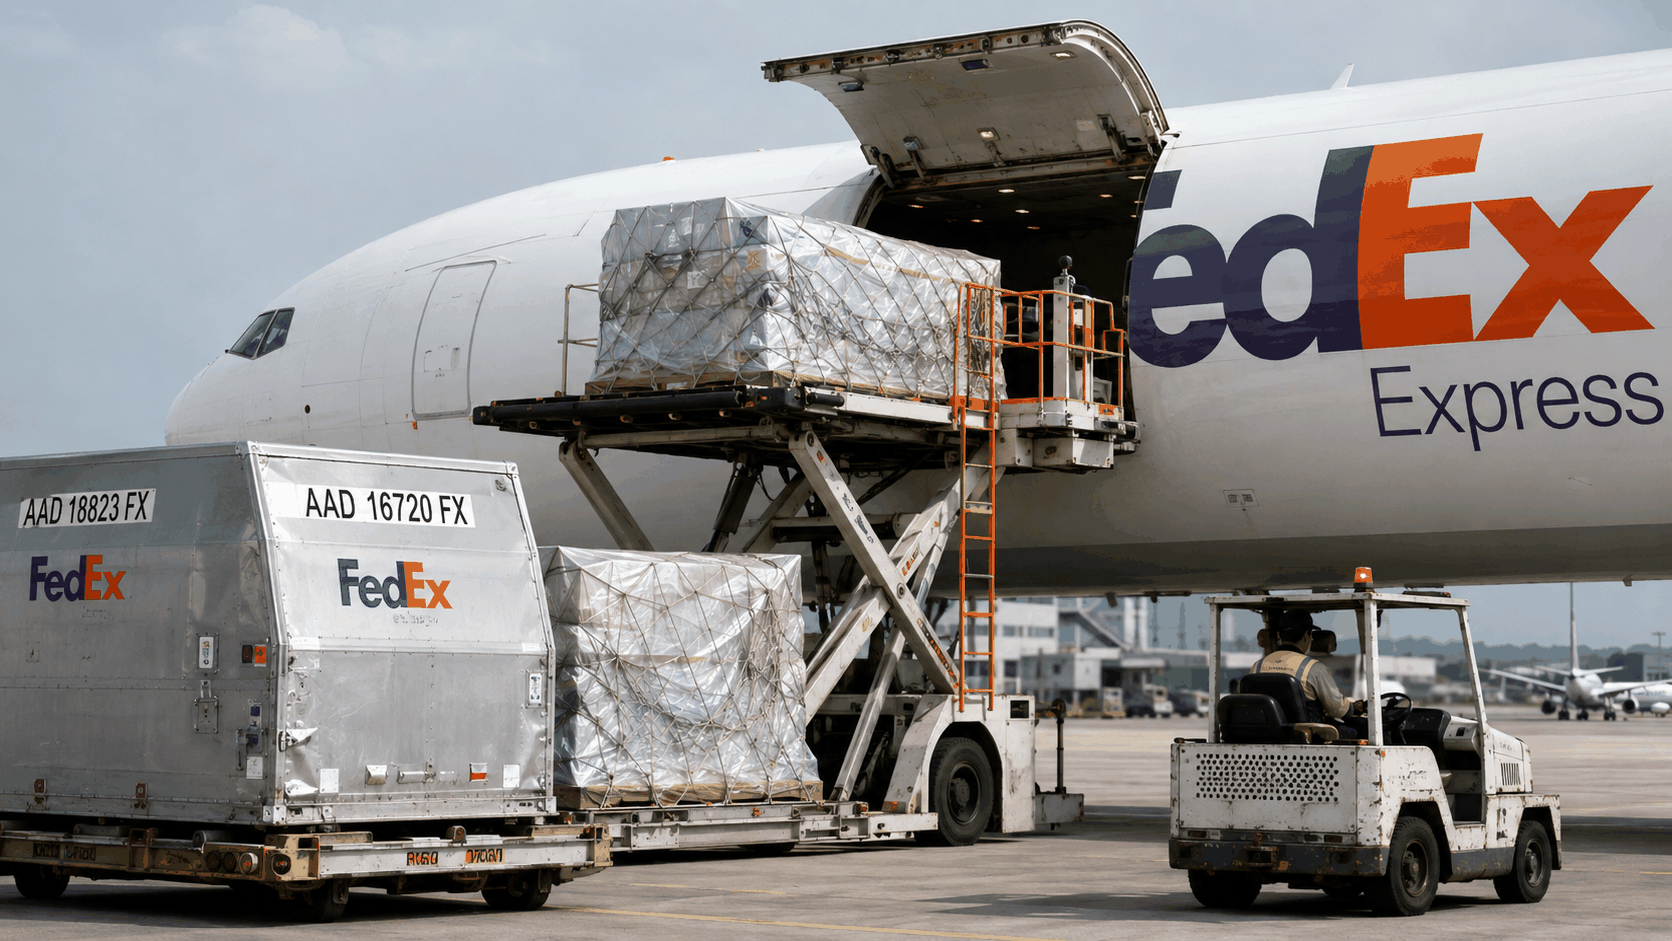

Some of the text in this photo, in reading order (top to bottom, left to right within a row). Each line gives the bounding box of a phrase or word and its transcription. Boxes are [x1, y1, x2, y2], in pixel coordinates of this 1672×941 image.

[1128, 133, 1656, 368] edEx
[1370, 366, 1664, 451] Express
[23, 490, 150, 526] AAD 18823 FX
[305, 487, 468, 525] AAD 16720 FX
[29, 554, 127, 602] FedEx
[337, 558, 453, 609] FedEx
